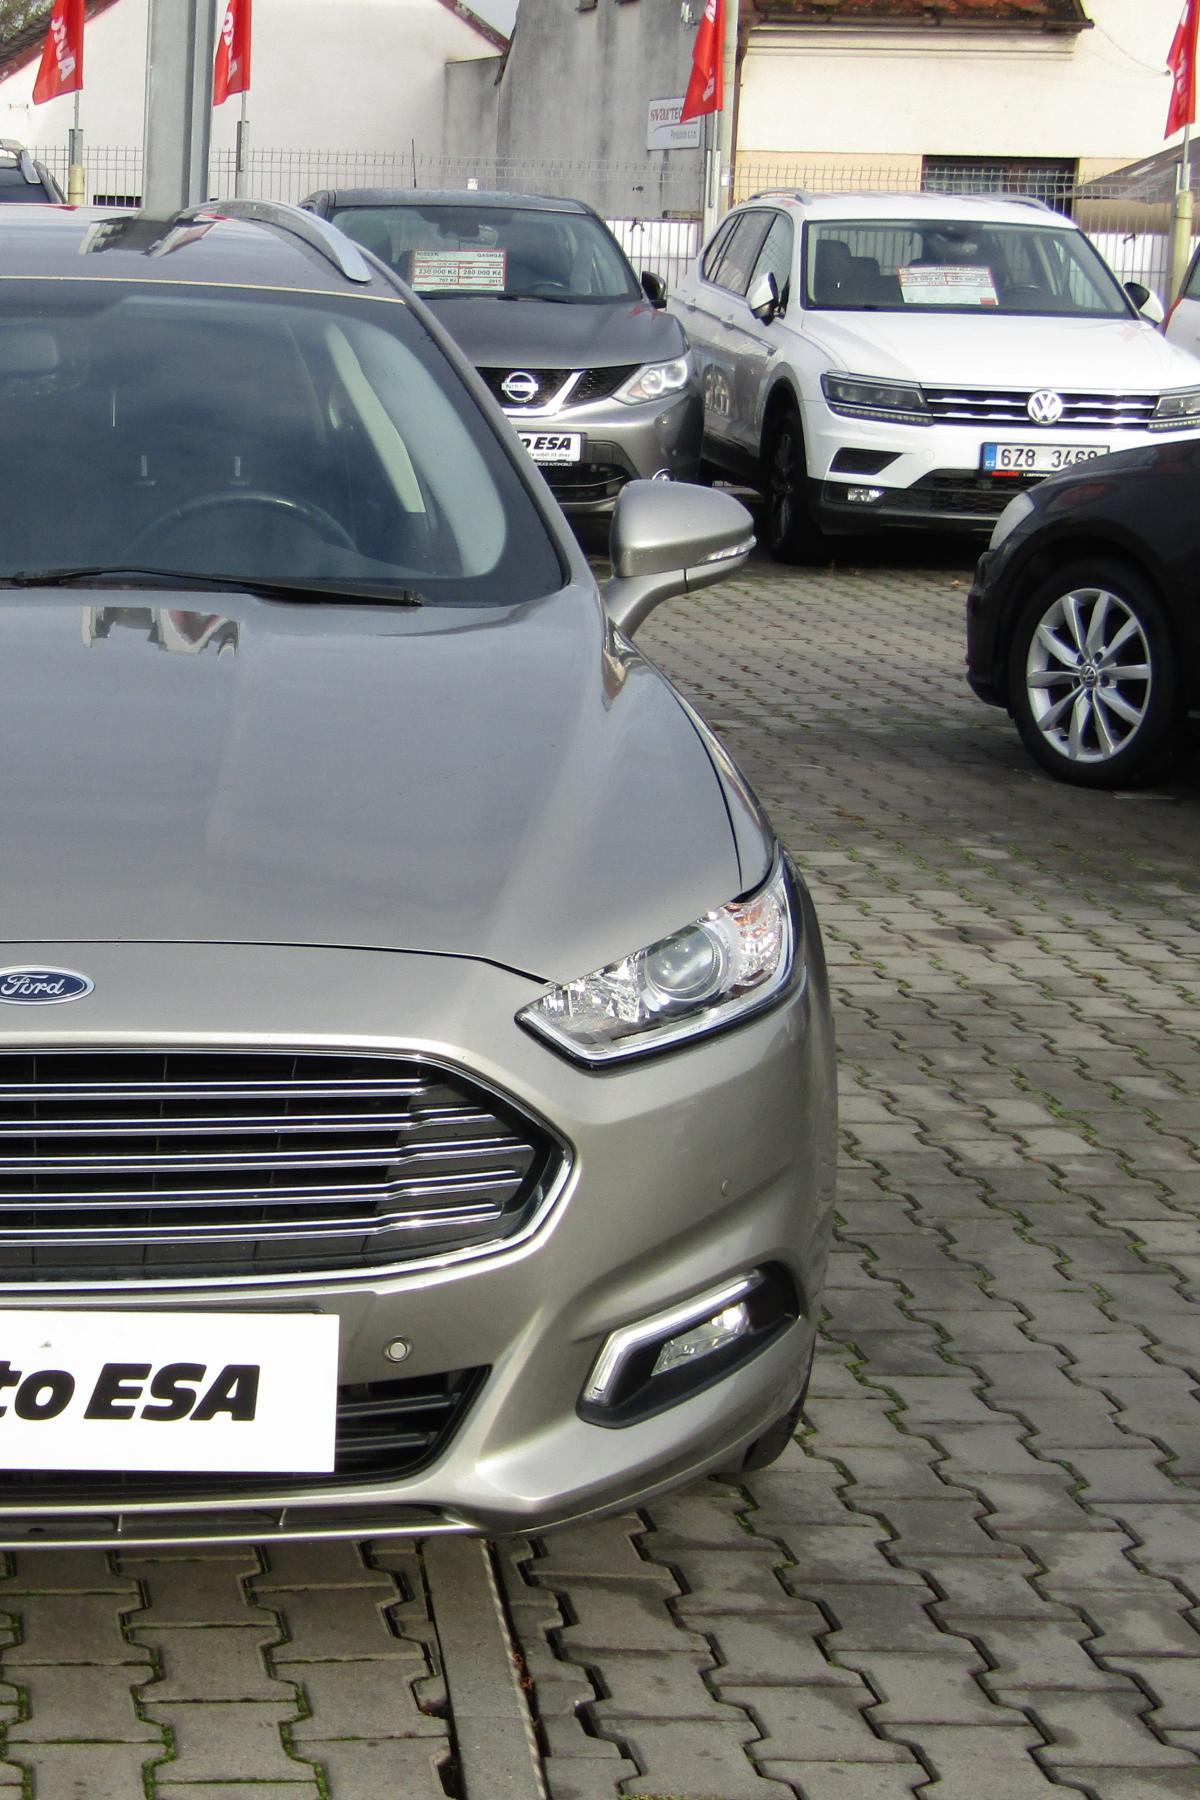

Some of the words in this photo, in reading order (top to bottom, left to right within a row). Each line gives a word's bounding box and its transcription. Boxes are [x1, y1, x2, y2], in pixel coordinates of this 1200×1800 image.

[533, 437, 572, 451] ESA
[1001, 448, 1036, 468] 6Z8
[0, 974, 65, 995] Ford
[83, 1362, 260, 1422] ESA
